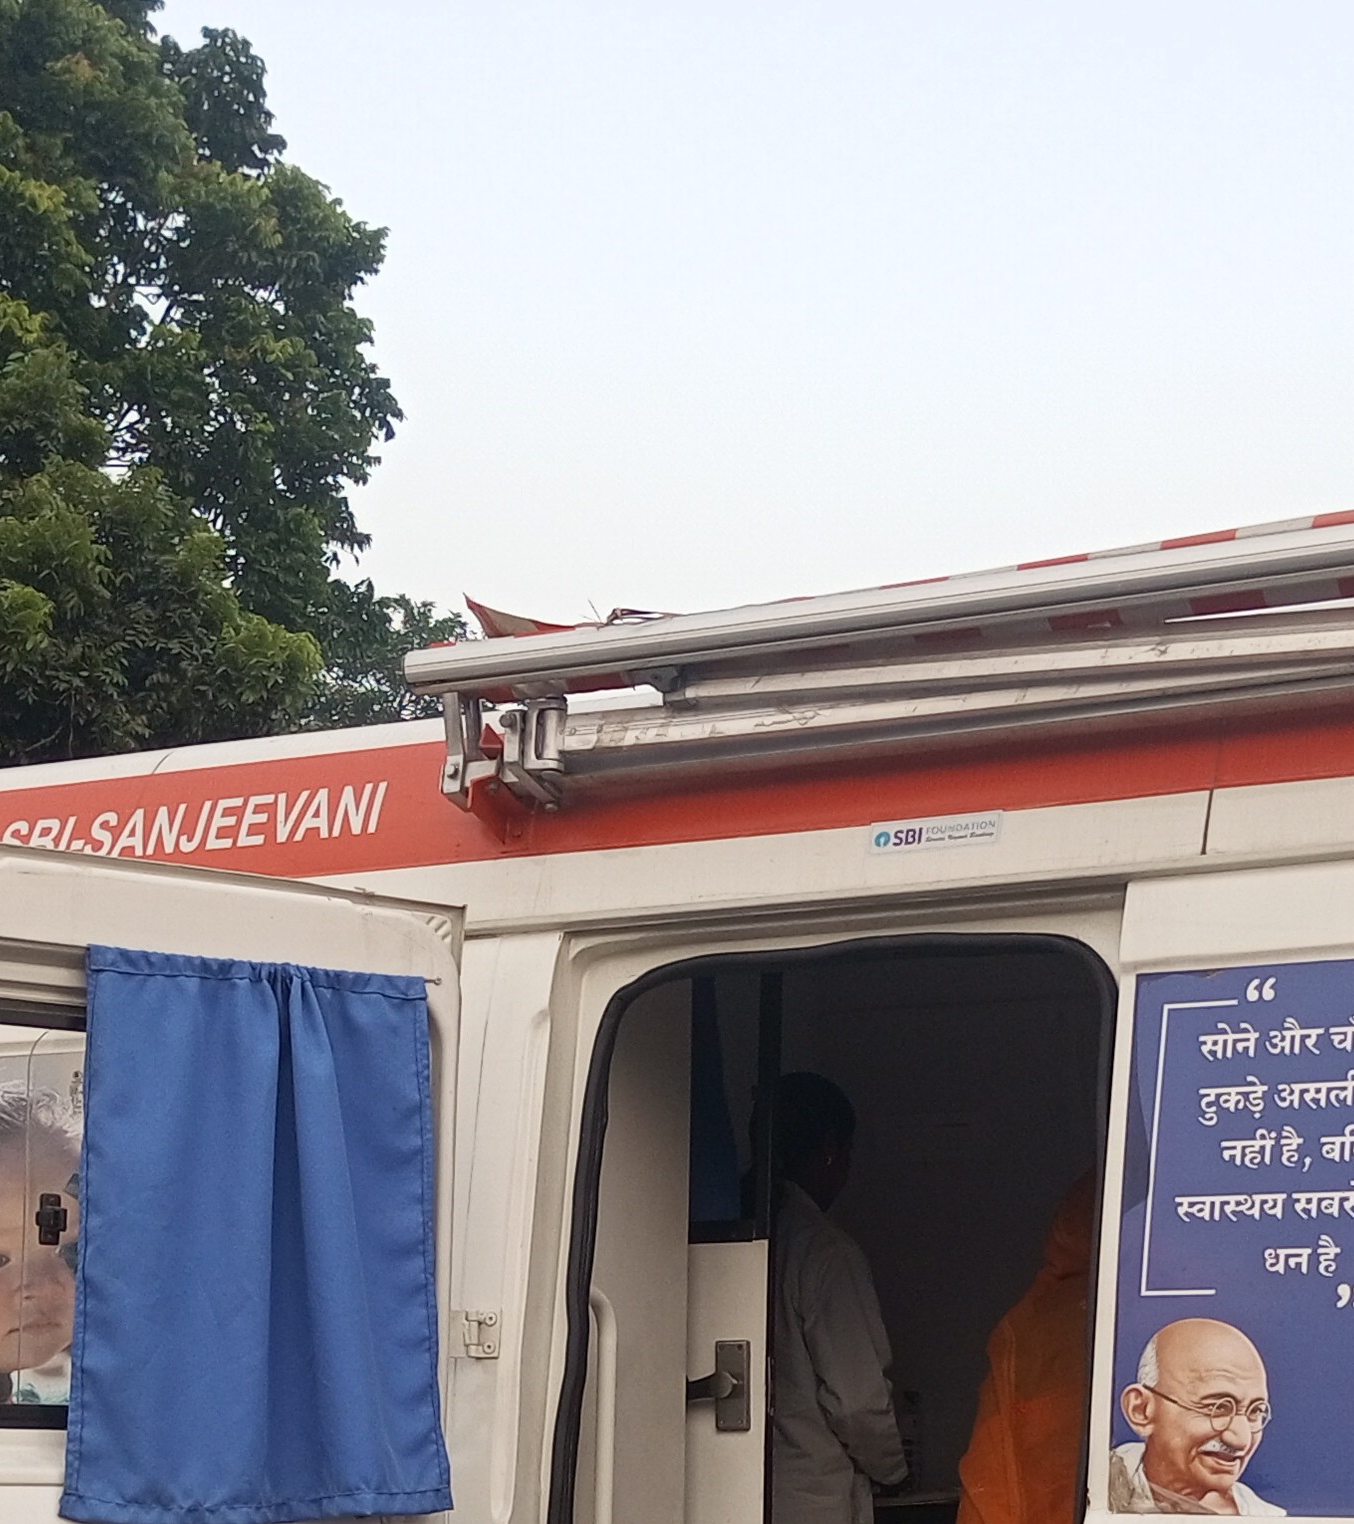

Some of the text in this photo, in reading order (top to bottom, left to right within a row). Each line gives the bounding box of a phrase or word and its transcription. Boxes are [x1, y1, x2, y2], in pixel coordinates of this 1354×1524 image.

[892, 827, 924, 847] SBI
[926, 820, 996, 836] FOUNDATION
[1199, 1022, 1260, 1062] सोने
[1265, 1017, 1325, 1056] और
[1198, 1075, 1269, 1127] टुकड़े
[1220, 1128, 1277, 1169] नहीं
[1280, 1125, 1313, 1173] है,
[1264, 1234, 1342, 1277] धन है
